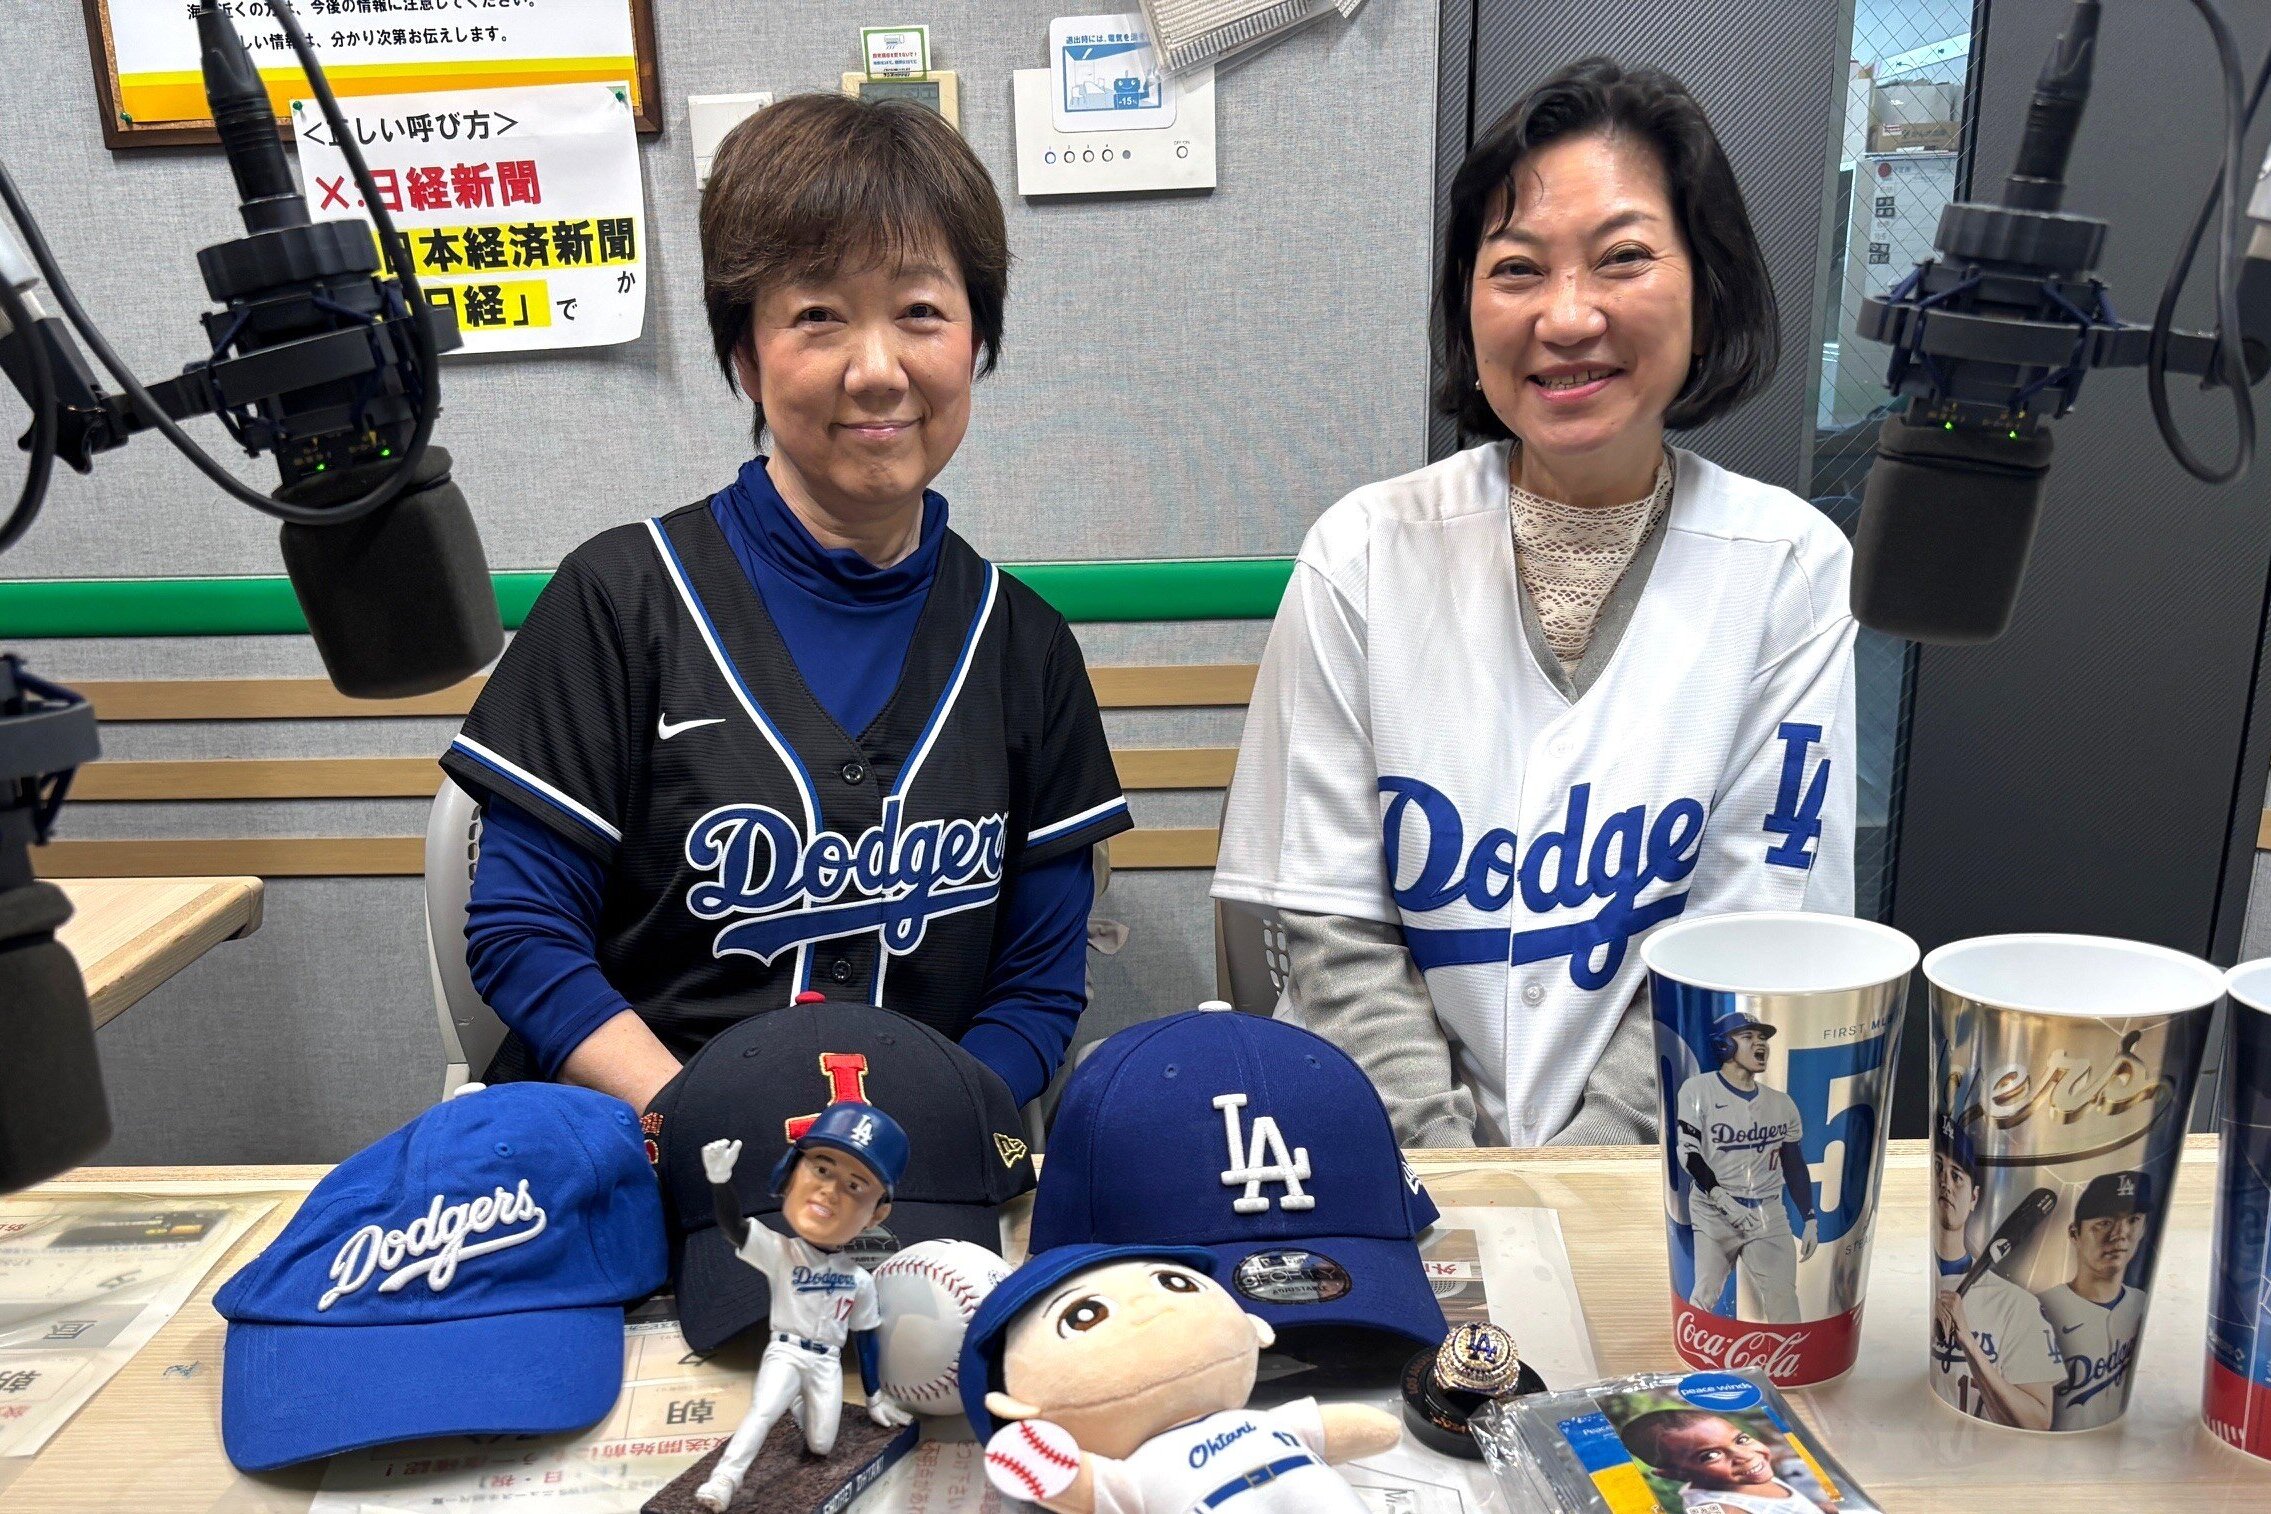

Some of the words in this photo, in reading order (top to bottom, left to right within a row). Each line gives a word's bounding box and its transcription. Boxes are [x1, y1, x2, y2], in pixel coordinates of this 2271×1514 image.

[303, 110, 519, 147] ＜しい呼び方＞
[685, 796, 1009, 955] Dodger
[1378, 782, 1704, 990] Dodge
[1823, 1023, 1866, 1040] FIRST
[851, 1114, 873, 1146] LA
[1711, 1121, 1788, 1153] Dodgers
[1213, 1093, 1315, 1213] LA
[2116, 1174, 2135, 1197] LA
[318, 1179, 546, 1312] Dodgers
[793, 1266, 857, 1295] Dodgers
[835, 1296, 854, 1321] 17
[1676, 1311, 1812, 1377] Coca-Cola
[1680, 1384, 1716, 1396] peace
[1716, 1381, 1752, 1391] winds
[666, 1399, 715, 1425] 朝
[1188, 1420, 1258, 1469] Ohtani
